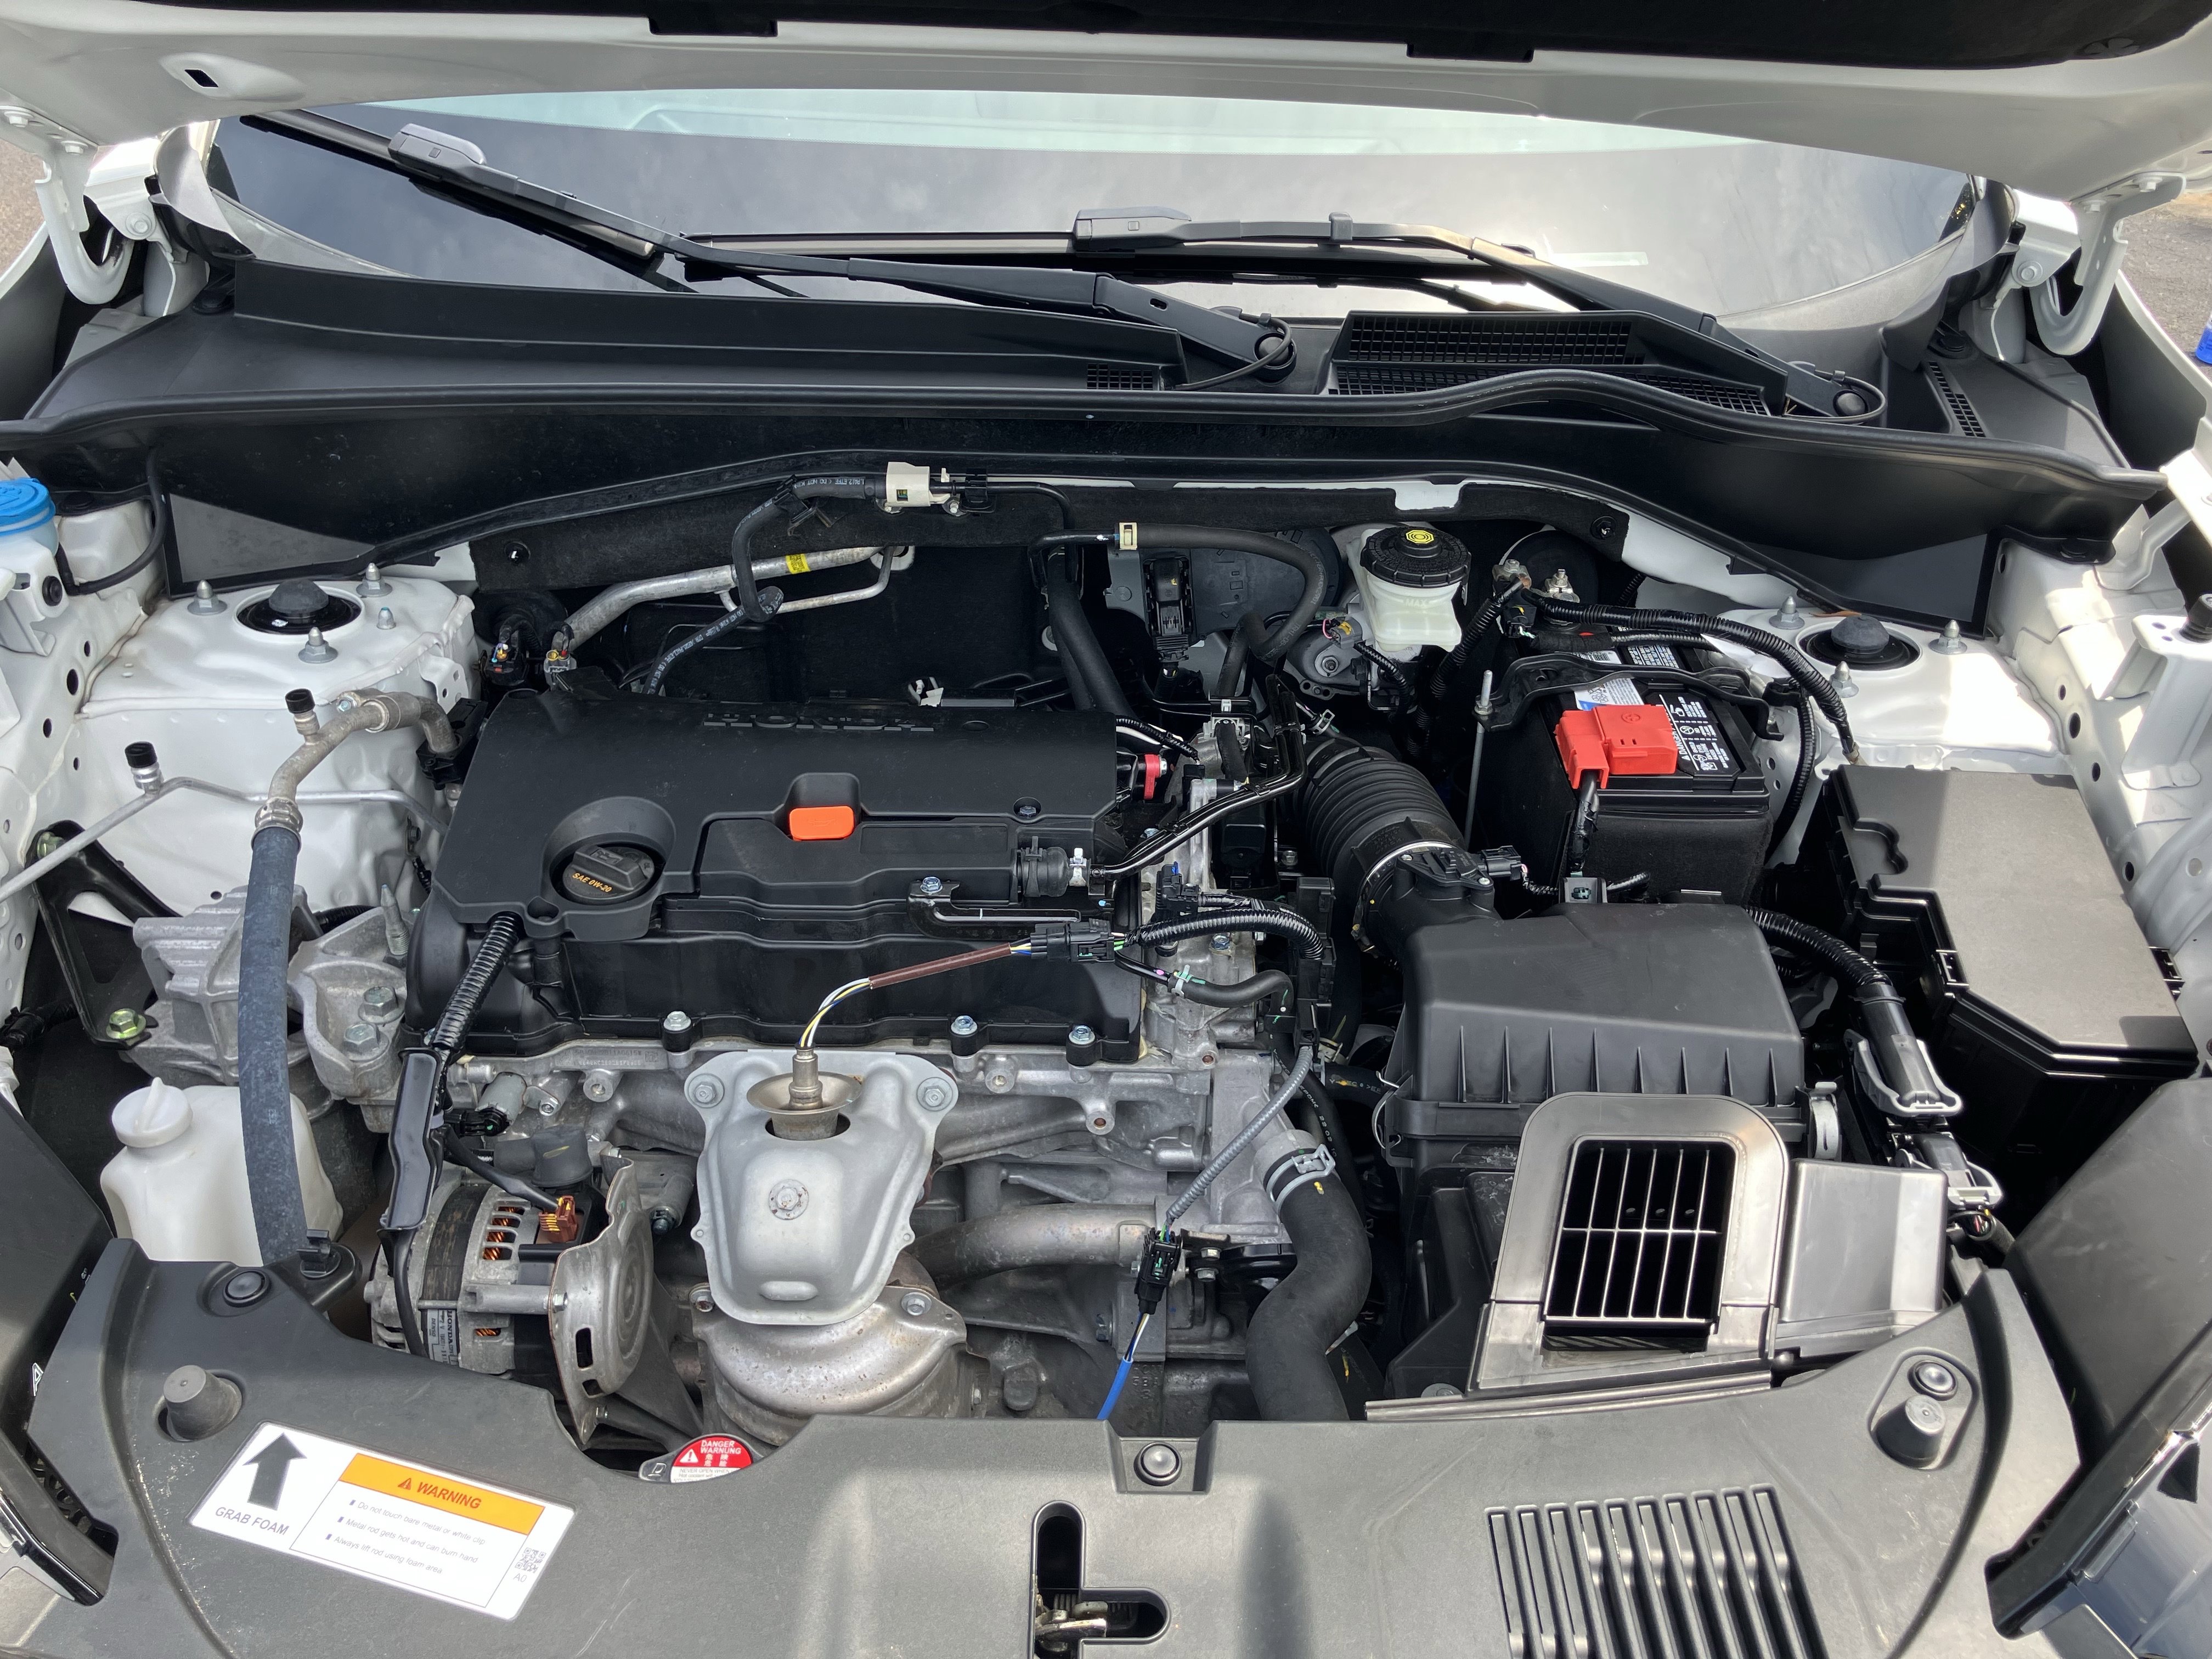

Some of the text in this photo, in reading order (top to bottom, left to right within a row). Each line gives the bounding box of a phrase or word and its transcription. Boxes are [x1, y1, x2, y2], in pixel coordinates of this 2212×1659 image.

[572, 872, 612, 893] SAE 0W-20
[417, 1482, 482, 1509] WARNING
[215, 1507, 290, 1535] GRAB FOAM
[357, 1502, 369, 1510] Do
[383, 1510, 403, 1519] touch
[403, 1516, 420, 1525] bare
[422, 1521, 442, 1532] metal
[452, 1531, 471, 1541] white
[334, 1536, 360, 1549] Always
[385, 1553, 404, 1564] using
[405, 1557, 425, 1568] foam
[425, 1565, 443, 1574] area
[346, 1519, 367, 1530] Metal
[380, 1530, 397, 1539] gets
[398, 1534, 410, 1543] hot
[410, 1539, 426, 1548] and
[441, 1548, 458, 1557] burn
[459, 1553, 478, 1563] hand
[513, 1573, 527, 1583] A0
